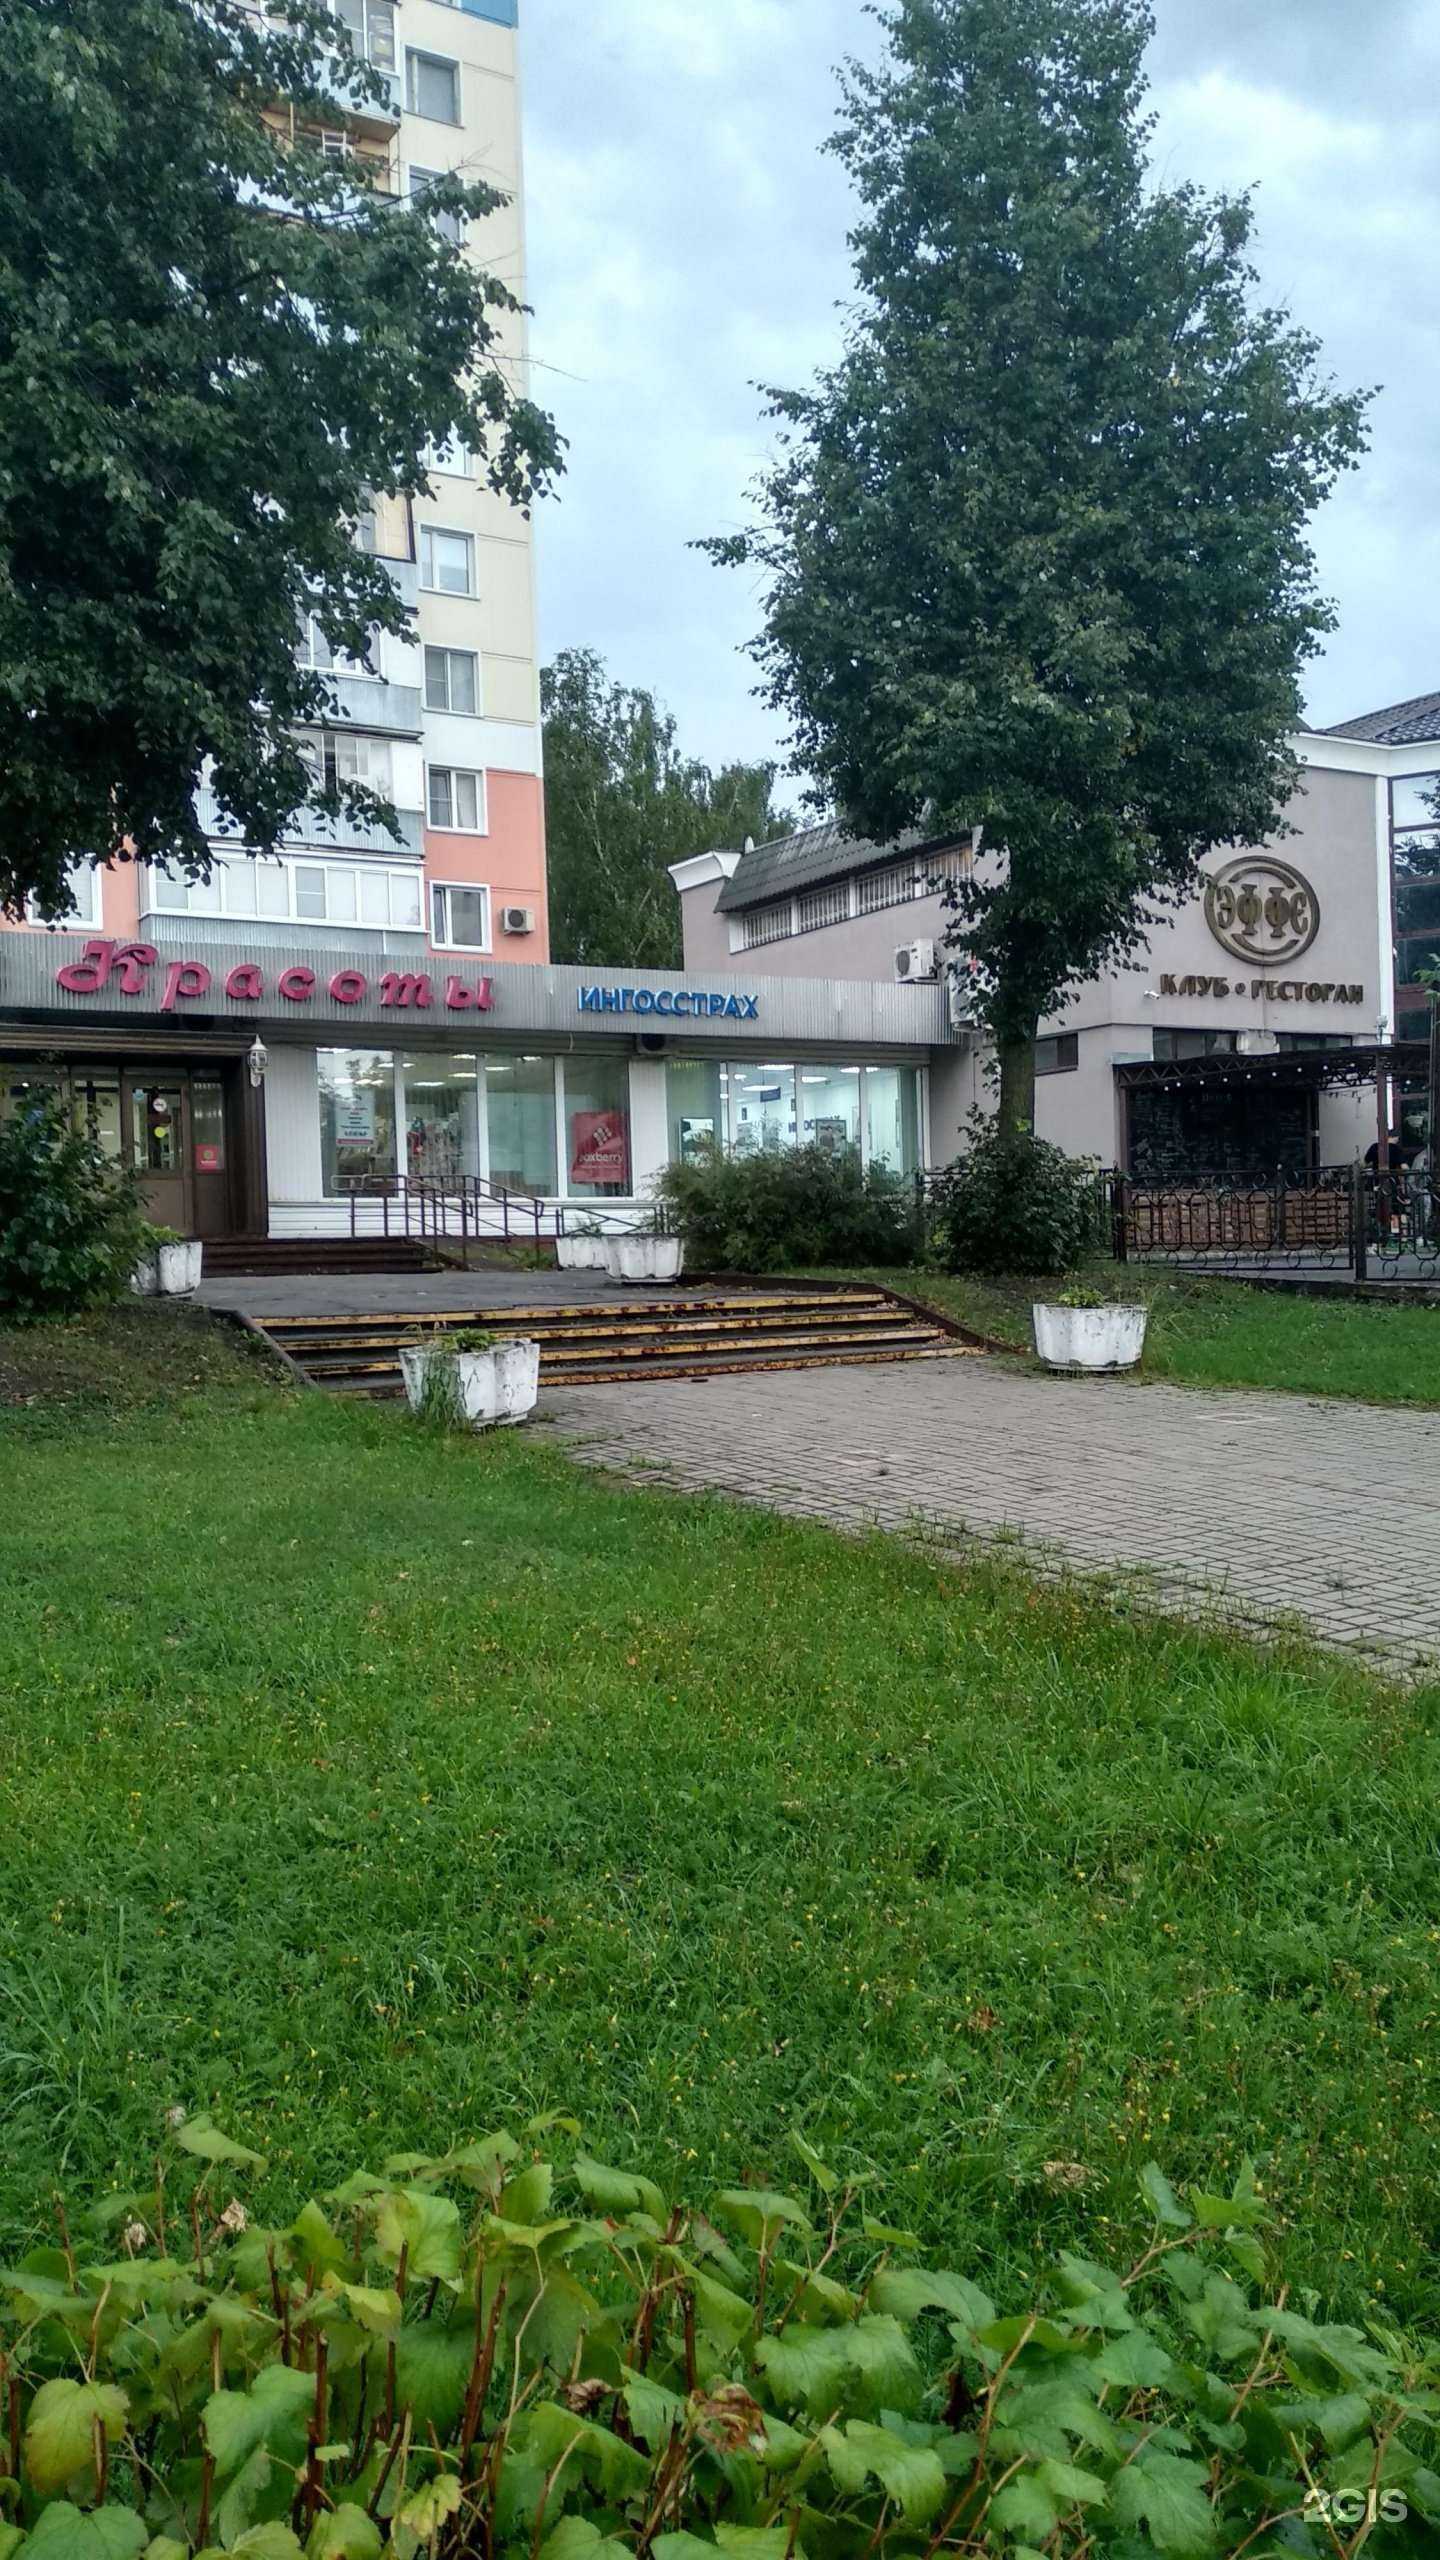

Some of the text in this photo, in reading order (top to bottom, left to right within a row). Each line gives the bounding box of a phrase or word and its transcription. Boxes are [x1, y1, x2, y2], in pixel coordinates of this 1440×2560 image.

[56, 940, 497, 1012] Красоты
[1160, 974, 1364, 1004] КЛУБ РЕСТОРАН
[577, 986, 759, 1019] ИНГОССТРАХ
